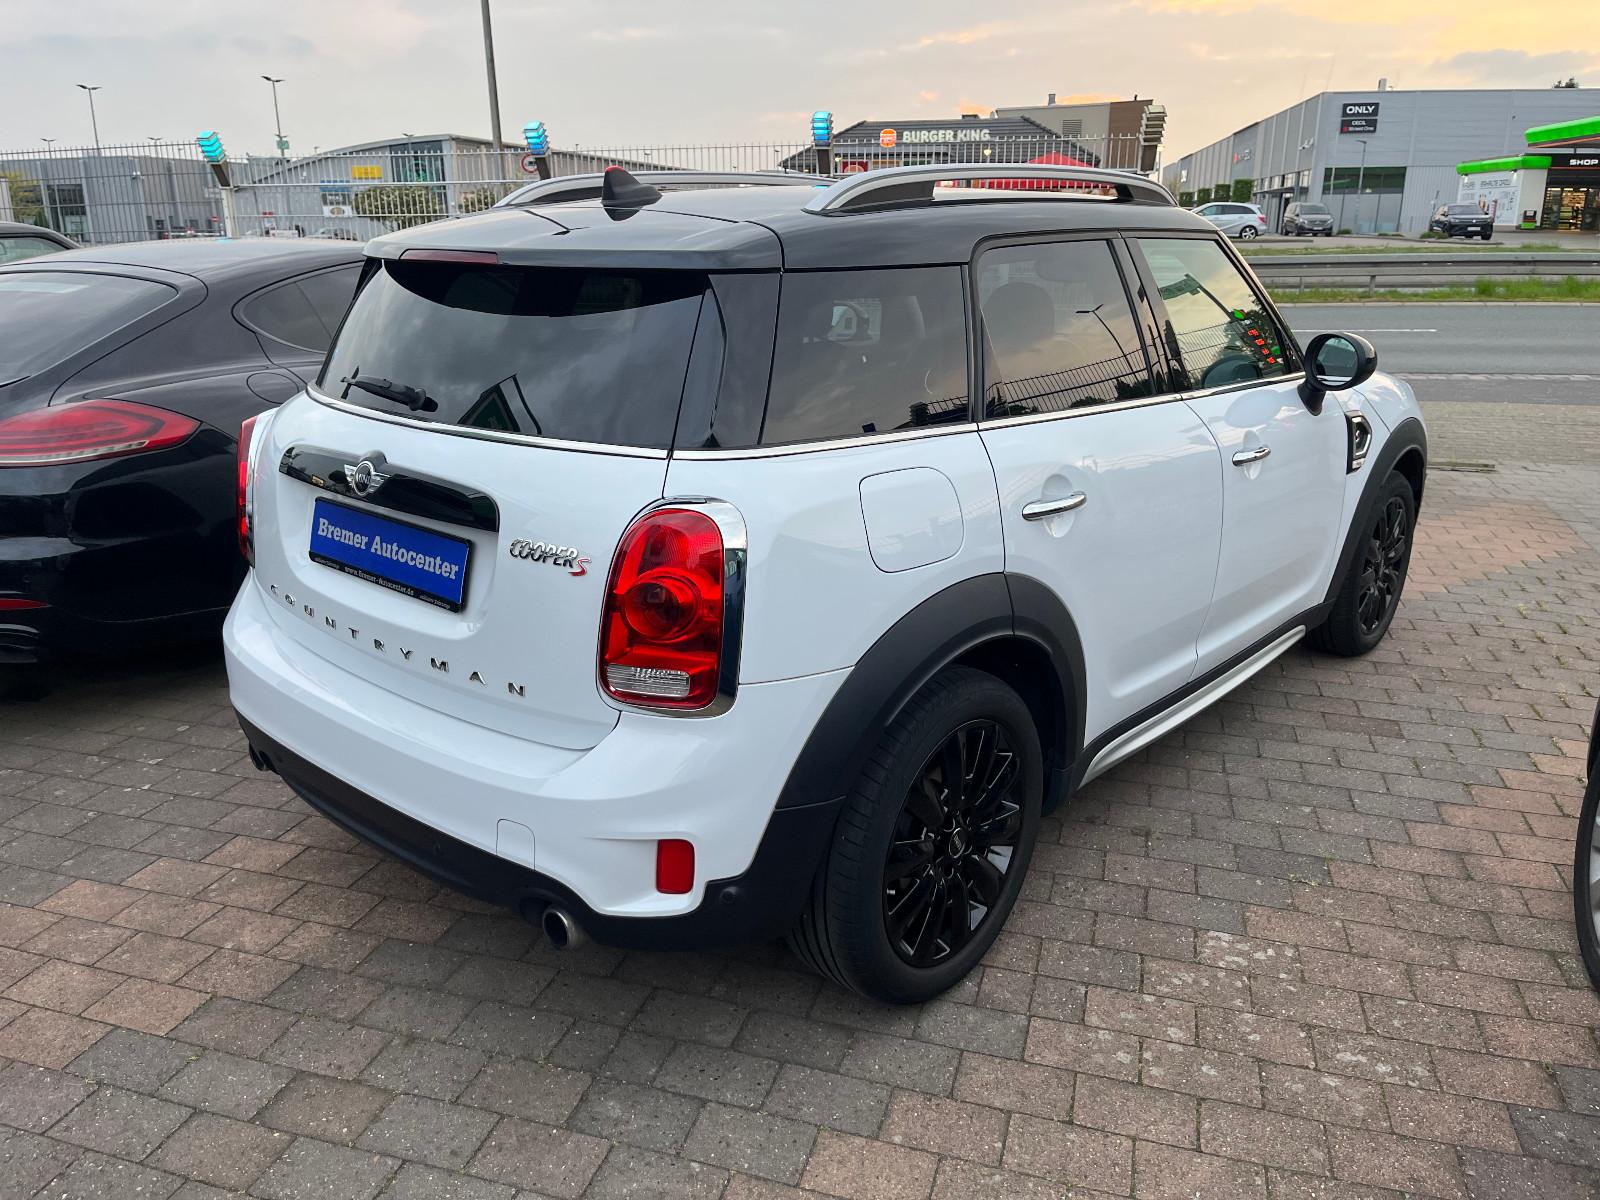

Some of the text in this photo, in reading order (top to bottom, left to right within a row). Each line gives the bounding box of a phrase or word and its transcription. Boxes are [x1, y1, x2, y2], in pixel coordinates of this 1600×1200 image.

[1346, 105, 1375, 114] ONLY
[902, 129, 954, 143] BURGER
[957, 128, 991, 141] KING
[318, 517, 459, 580] Bremer Autocenter
[510, 538, 579, 569] COOPER
[270, 584, 526, 697] COUNTRYMAN
